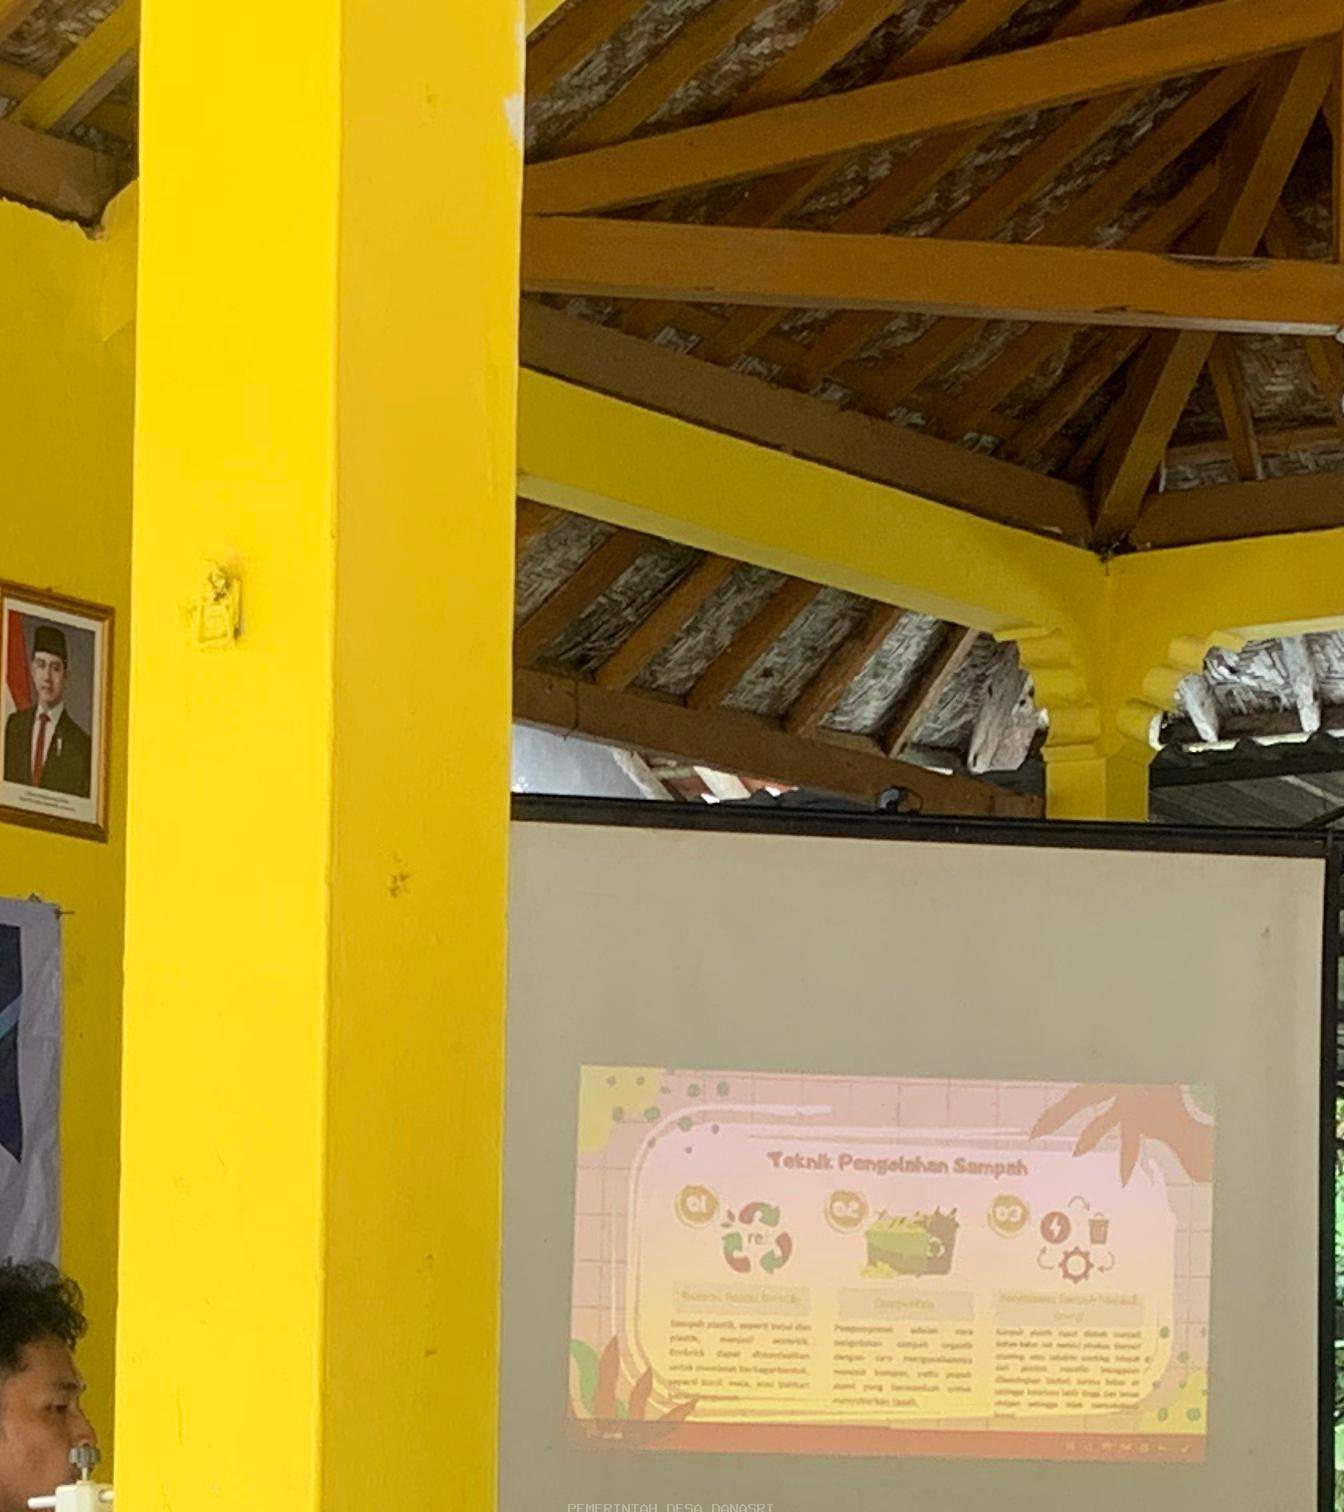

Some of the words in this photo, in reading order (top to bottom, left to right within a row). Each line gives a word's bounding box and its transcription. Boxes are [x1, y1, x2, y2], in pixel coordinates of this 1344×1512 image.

[767, 1151, 833, 1170] Teknik
[838, 1153, 949, 1176] Pengolahan
[953, 1157, 1029, 1180] Sampah
